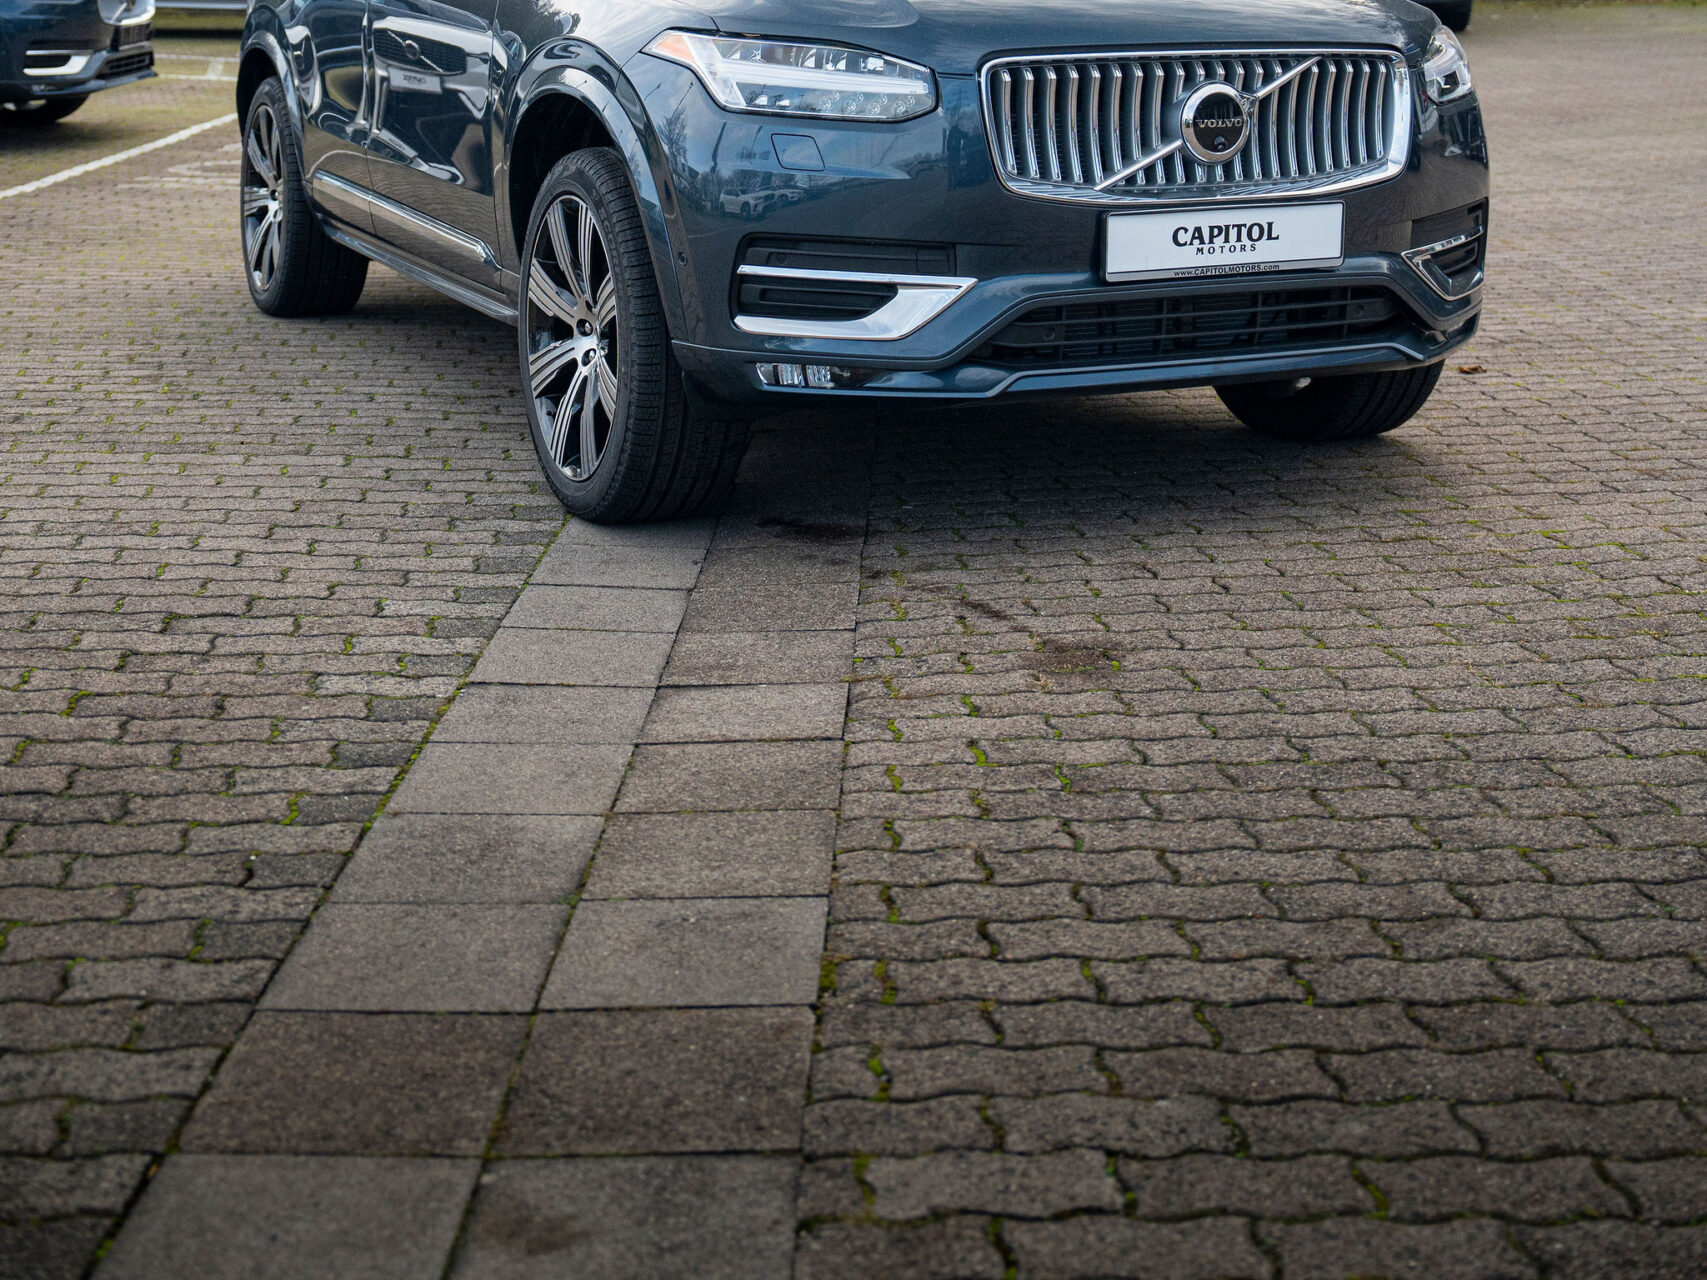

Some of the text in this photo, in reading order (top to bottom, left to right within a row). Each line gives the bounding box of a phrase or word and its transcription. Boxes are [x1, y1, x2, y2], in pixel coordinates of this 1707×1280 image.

[1196, 118, 1243, 128] VOLVO
[1172, 222, 1280, 247] CAPITOL
[1195, 243, 1257, 255] MOTORS
[1174, 264, 1280, 276] www.CAPITOLMOTORS.com
